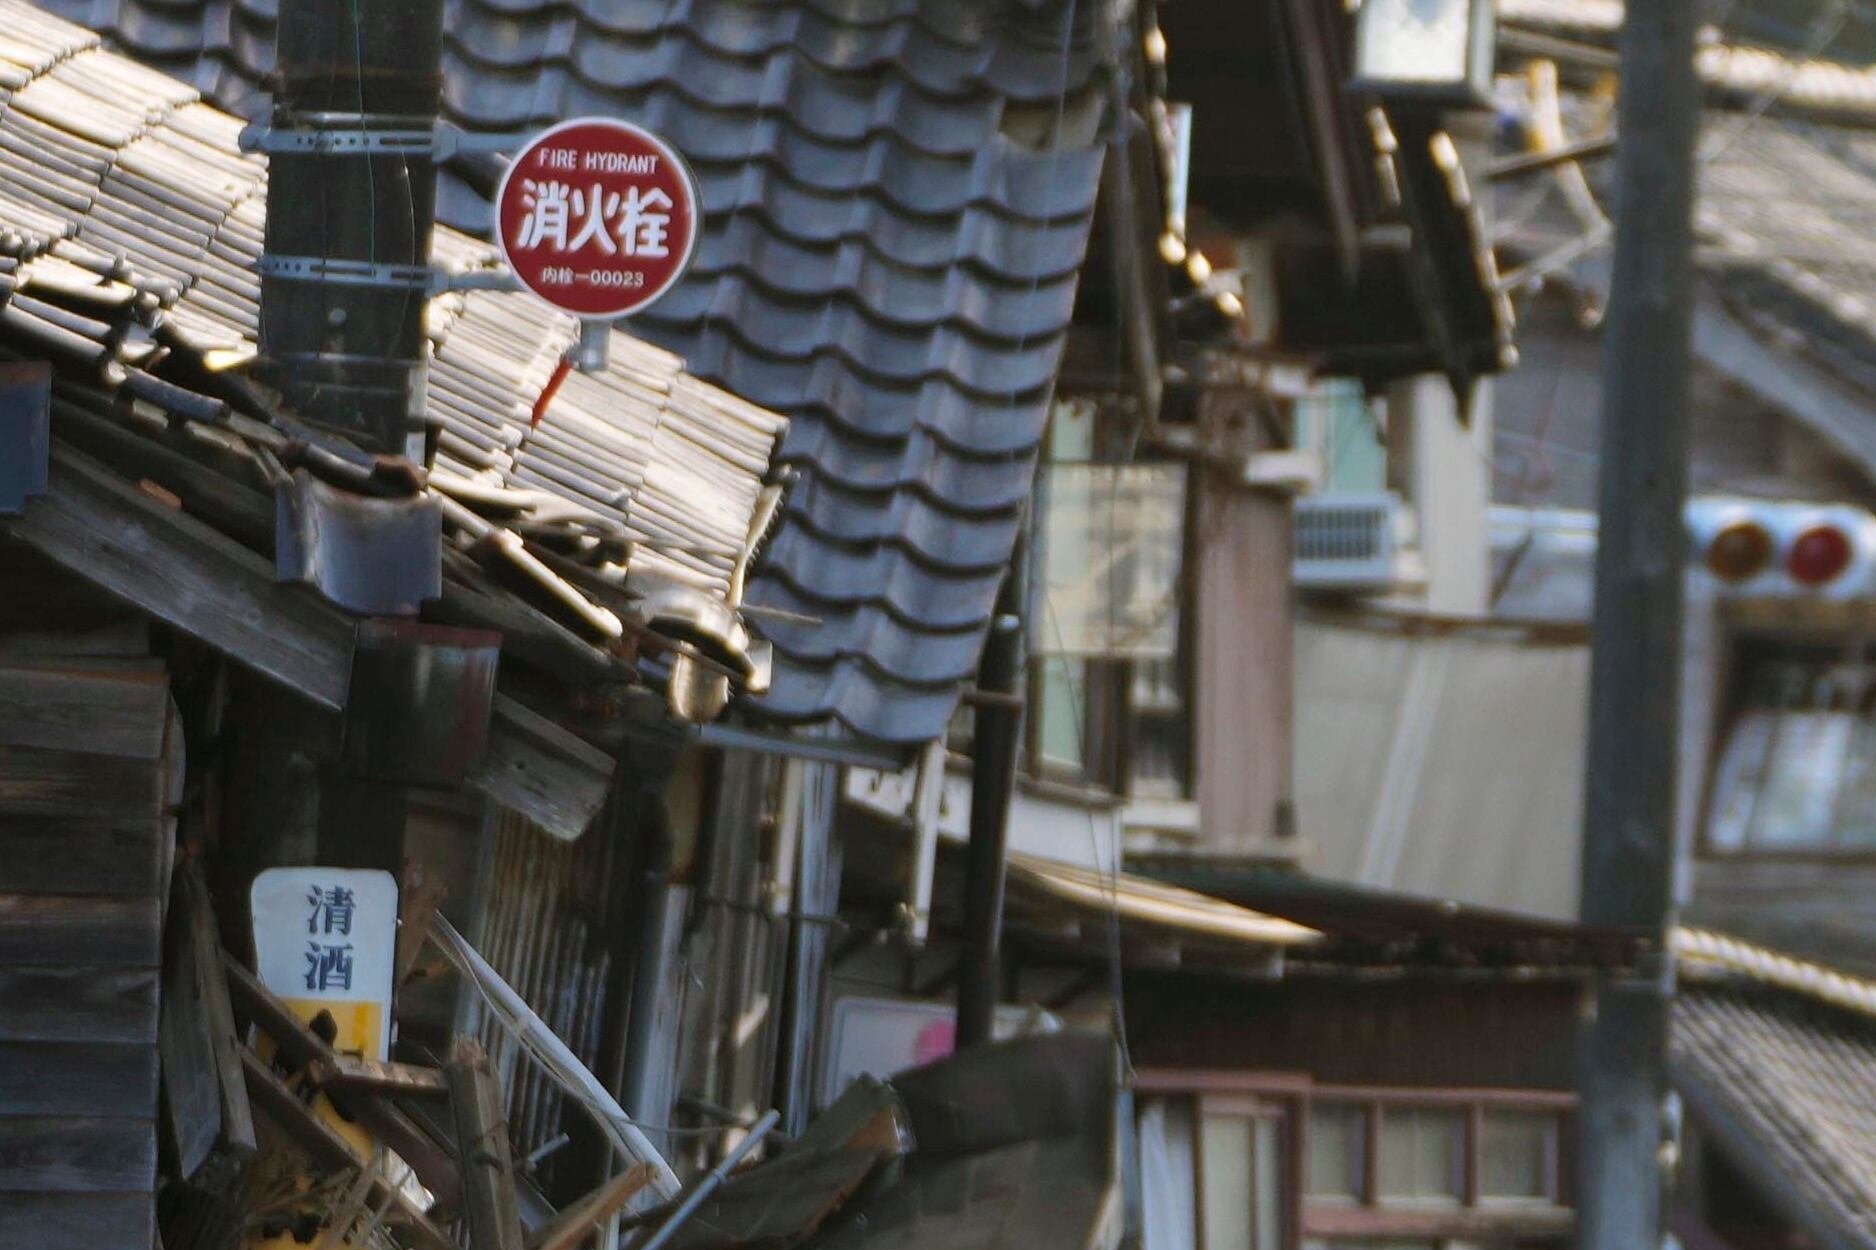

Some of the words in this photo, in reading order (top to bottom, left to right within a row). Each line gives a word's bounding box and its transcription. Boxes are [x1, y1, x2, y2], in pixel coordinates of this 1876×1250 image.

[538, 148, 578, 168] FIRE
[585, 150, 659, 174] HYDRANT
[517, 177, 674, 257] 消火栓
[303, 884, 356, 991] 清酒
